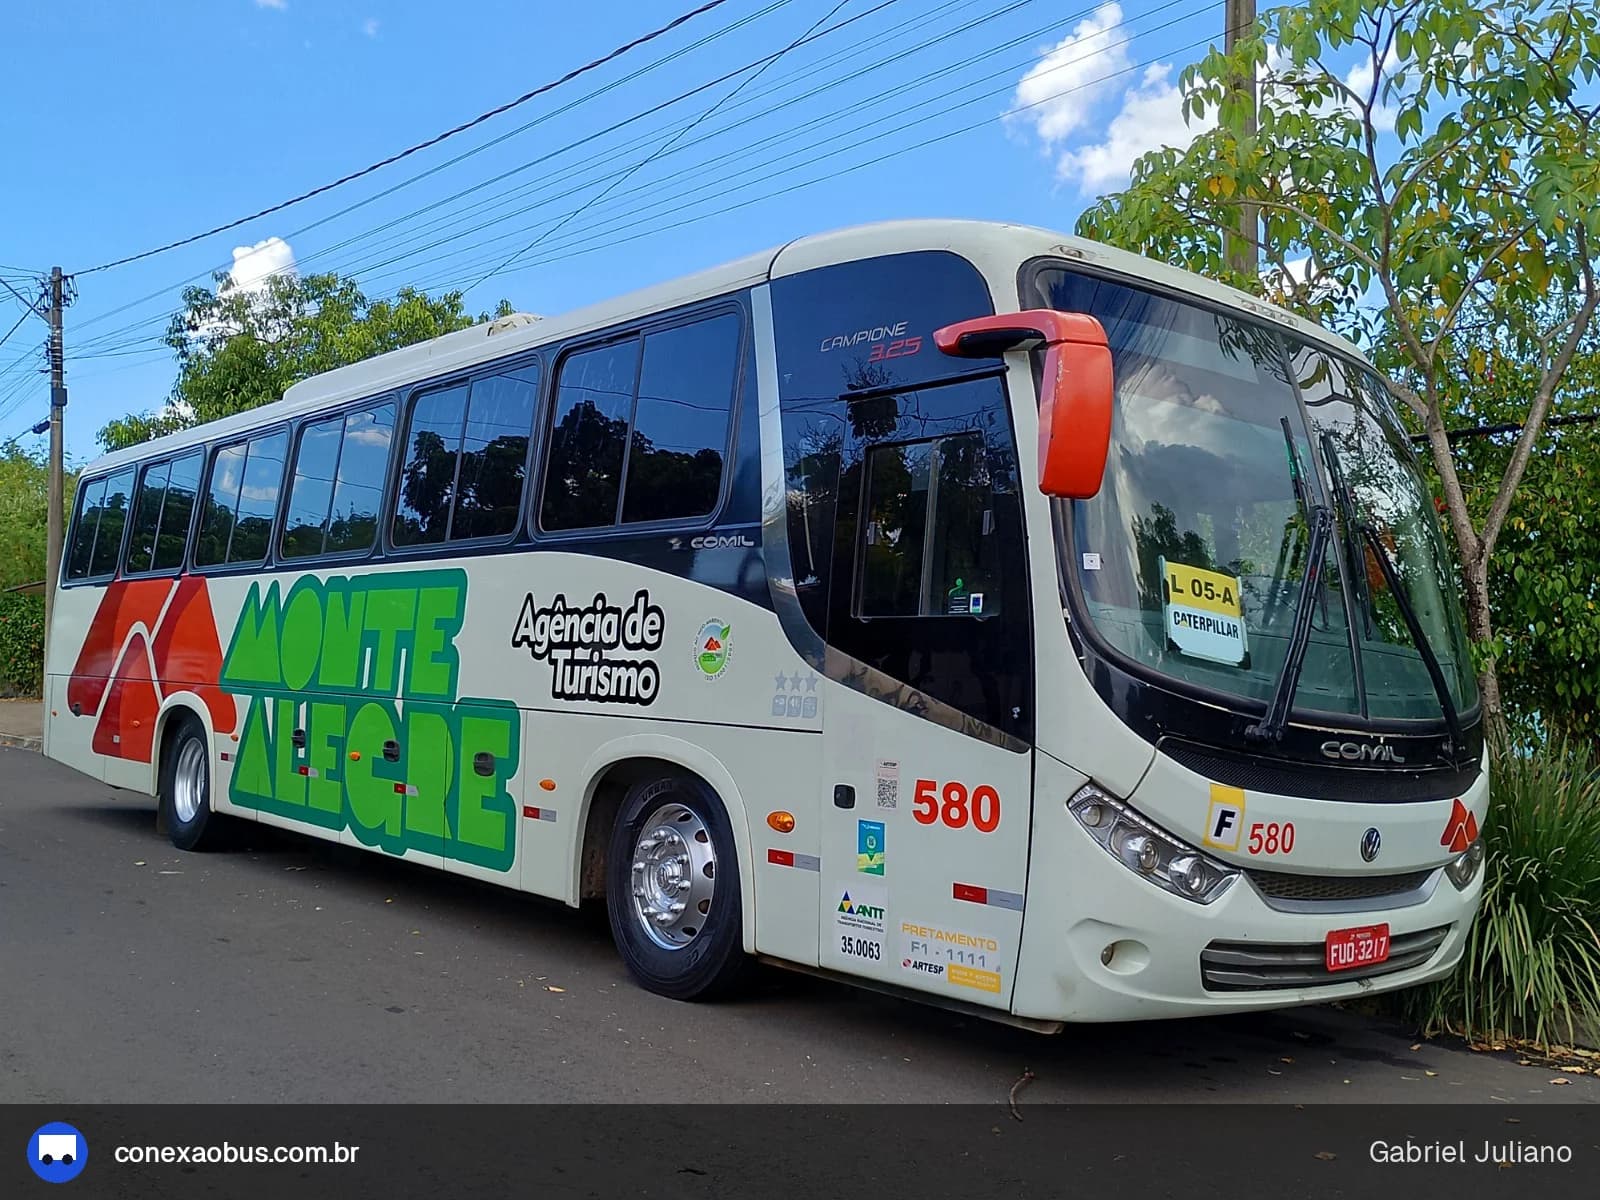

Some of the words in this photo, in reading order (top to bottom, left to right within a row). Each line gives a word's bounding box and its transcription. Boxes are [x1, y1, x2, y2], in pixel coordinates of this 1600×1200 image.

[820, 321, 908, 352] CAMPIONE
[868, 336, 922, 362] 3.25
[690, 535, 755, 549] COMIL
[1171, 574, 1184, 594] L
[1191, 578, 1235, 606] 05-A
[223, 585, 460, 691] MONTE
[513, 594, 619, 655] Agência
[623, 593, 662, 648] de
[1173, 611, 1239, 639] CATERPILLAR
[551, 648, 658, 701] Turismo
[1320, 741, 1405, 763] COMIL
[234, 696, 511, 852] ALEGRE
[912, 779, 1001, 833] 580
[1214, 809, 1235, 838] F
[1247, 822, 1295, 855] 580
[855, 904, 885, 920] ANTT
[841, 935, 880, 961] 35.0063
[902, 922, 998, 951] FRETAMENTO
[912, 960, 944, 975] ARTESP
